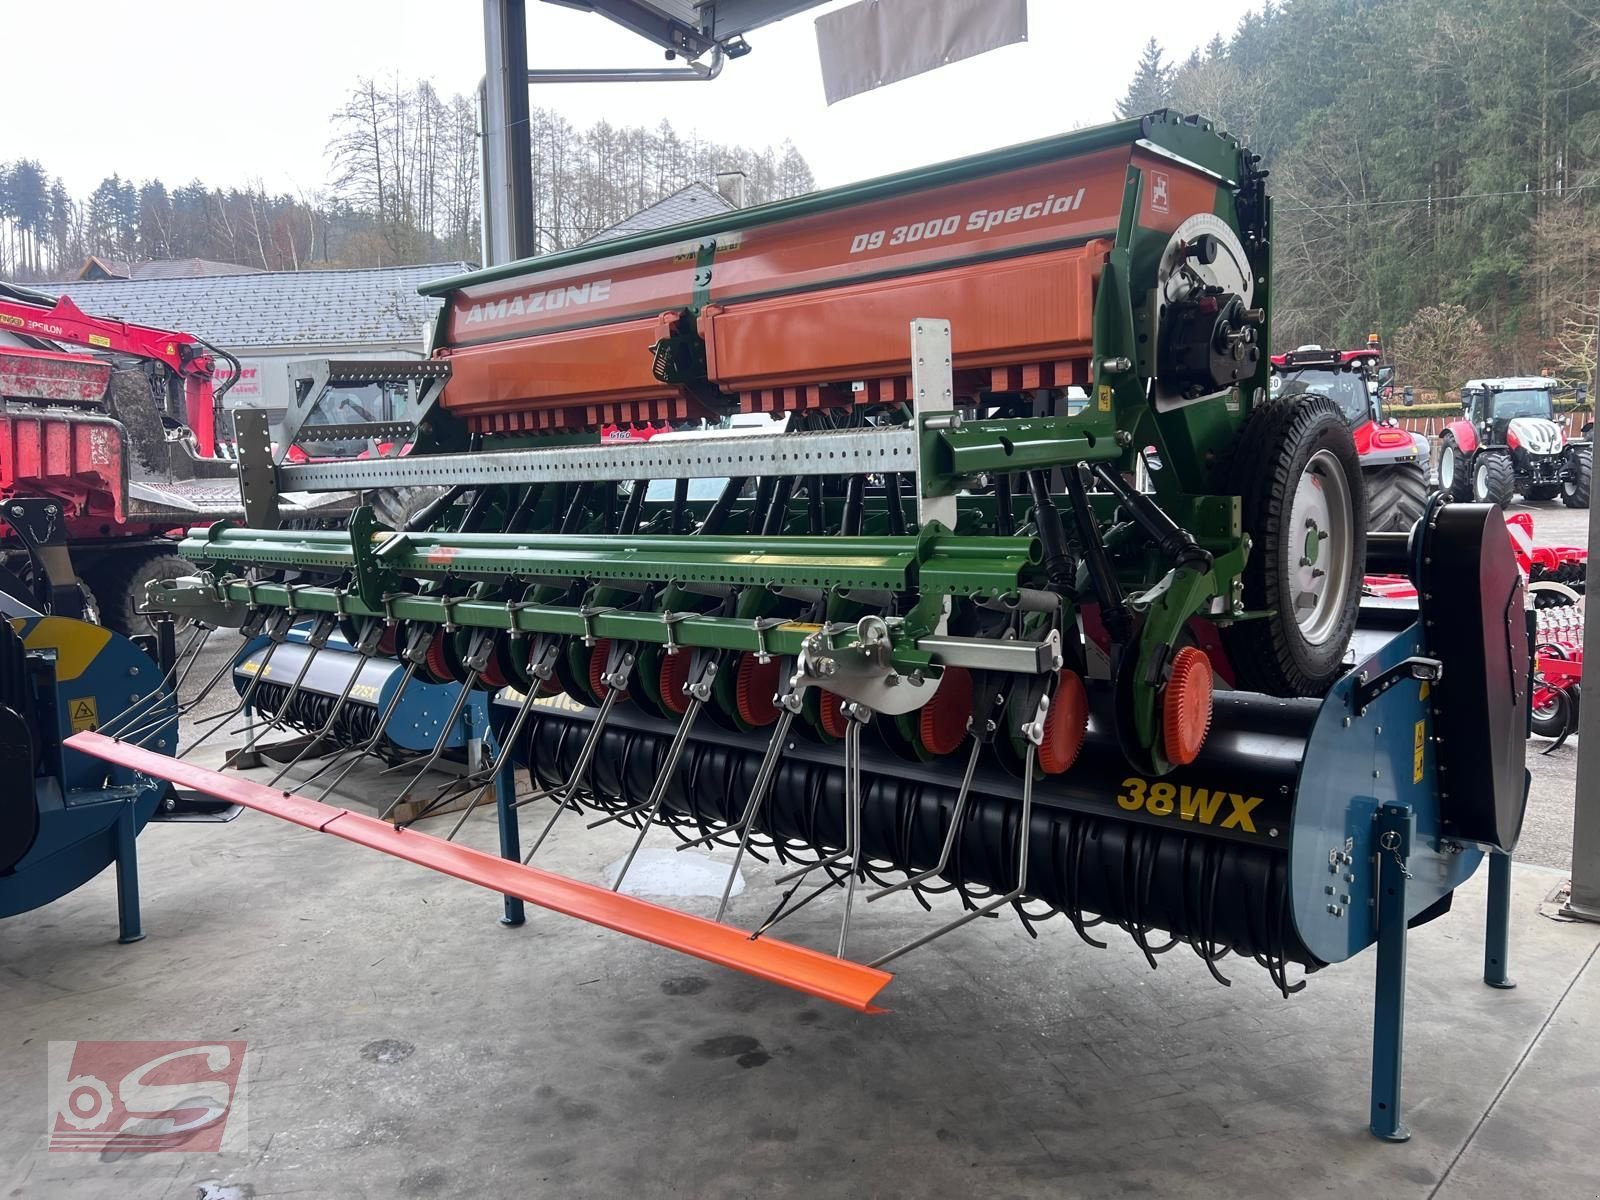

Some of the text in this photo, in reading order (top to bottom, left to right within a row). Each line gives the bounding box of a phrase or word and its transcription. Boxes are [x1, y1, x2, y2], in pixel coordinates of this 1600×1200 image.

[849, 188, 1087, 254] D9 3000 Special
[464, 279, 612, 325] AMAZONE
[1117, 777, 1265, 833] 38WX
